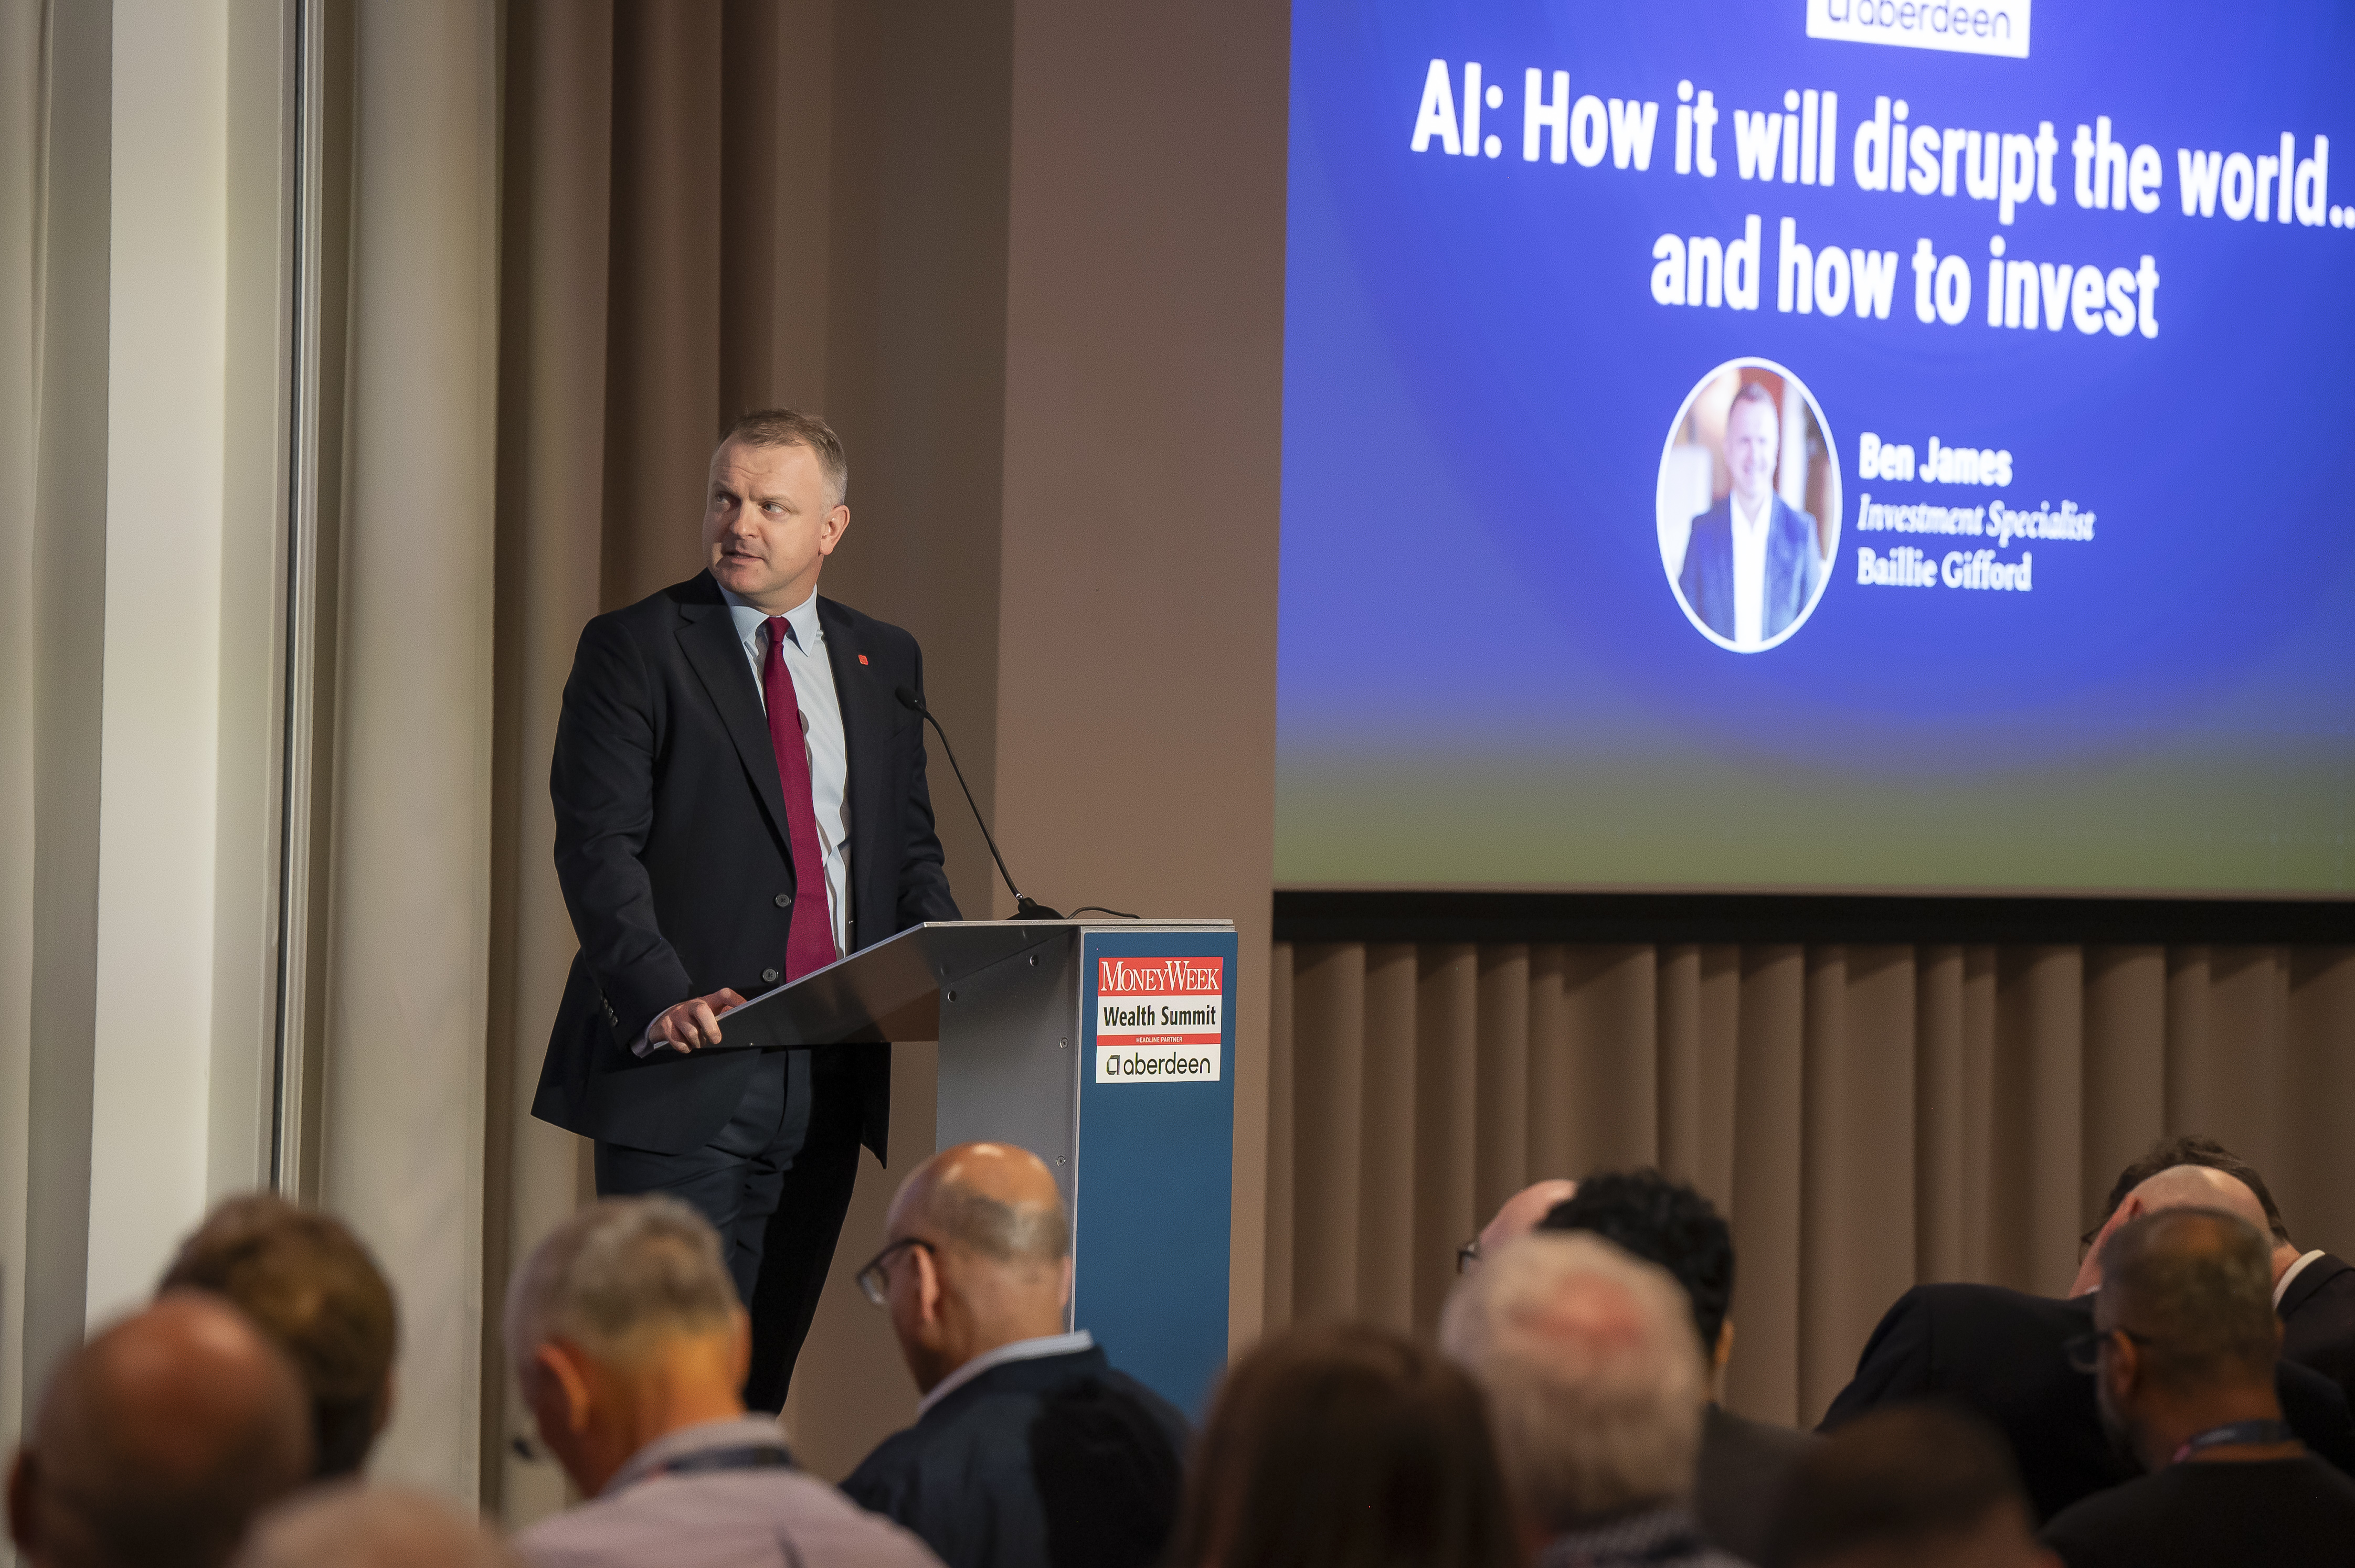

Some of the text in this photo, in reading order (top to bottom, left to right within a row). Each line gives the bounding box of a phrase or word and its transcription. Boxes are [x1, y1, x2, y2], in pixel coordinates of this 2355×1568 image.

[1858, 0, 2011, 39] aberdeen
[1410, 58, 1504, 159] AI:
[1523, 67, 1660, 171] How
[1674, 79, 1719, 178] it
[1733, 88, 1838, 187] will
[1852, 94, 2060, 226] disrupt
[2072, 115, 2163, 214] the
[1650, 213, 2160, 339] and how to invest
[1858, 431, 2013, 487] Ben James
[1857, 493, 2096, 548] Investment Specialist
[1857, 546, 2033, 592] Baillie Gifford
[1103, 1004, 1216, 1027] Wealth Summit
[1123, 1051, 1211, 1075] aberdeen
